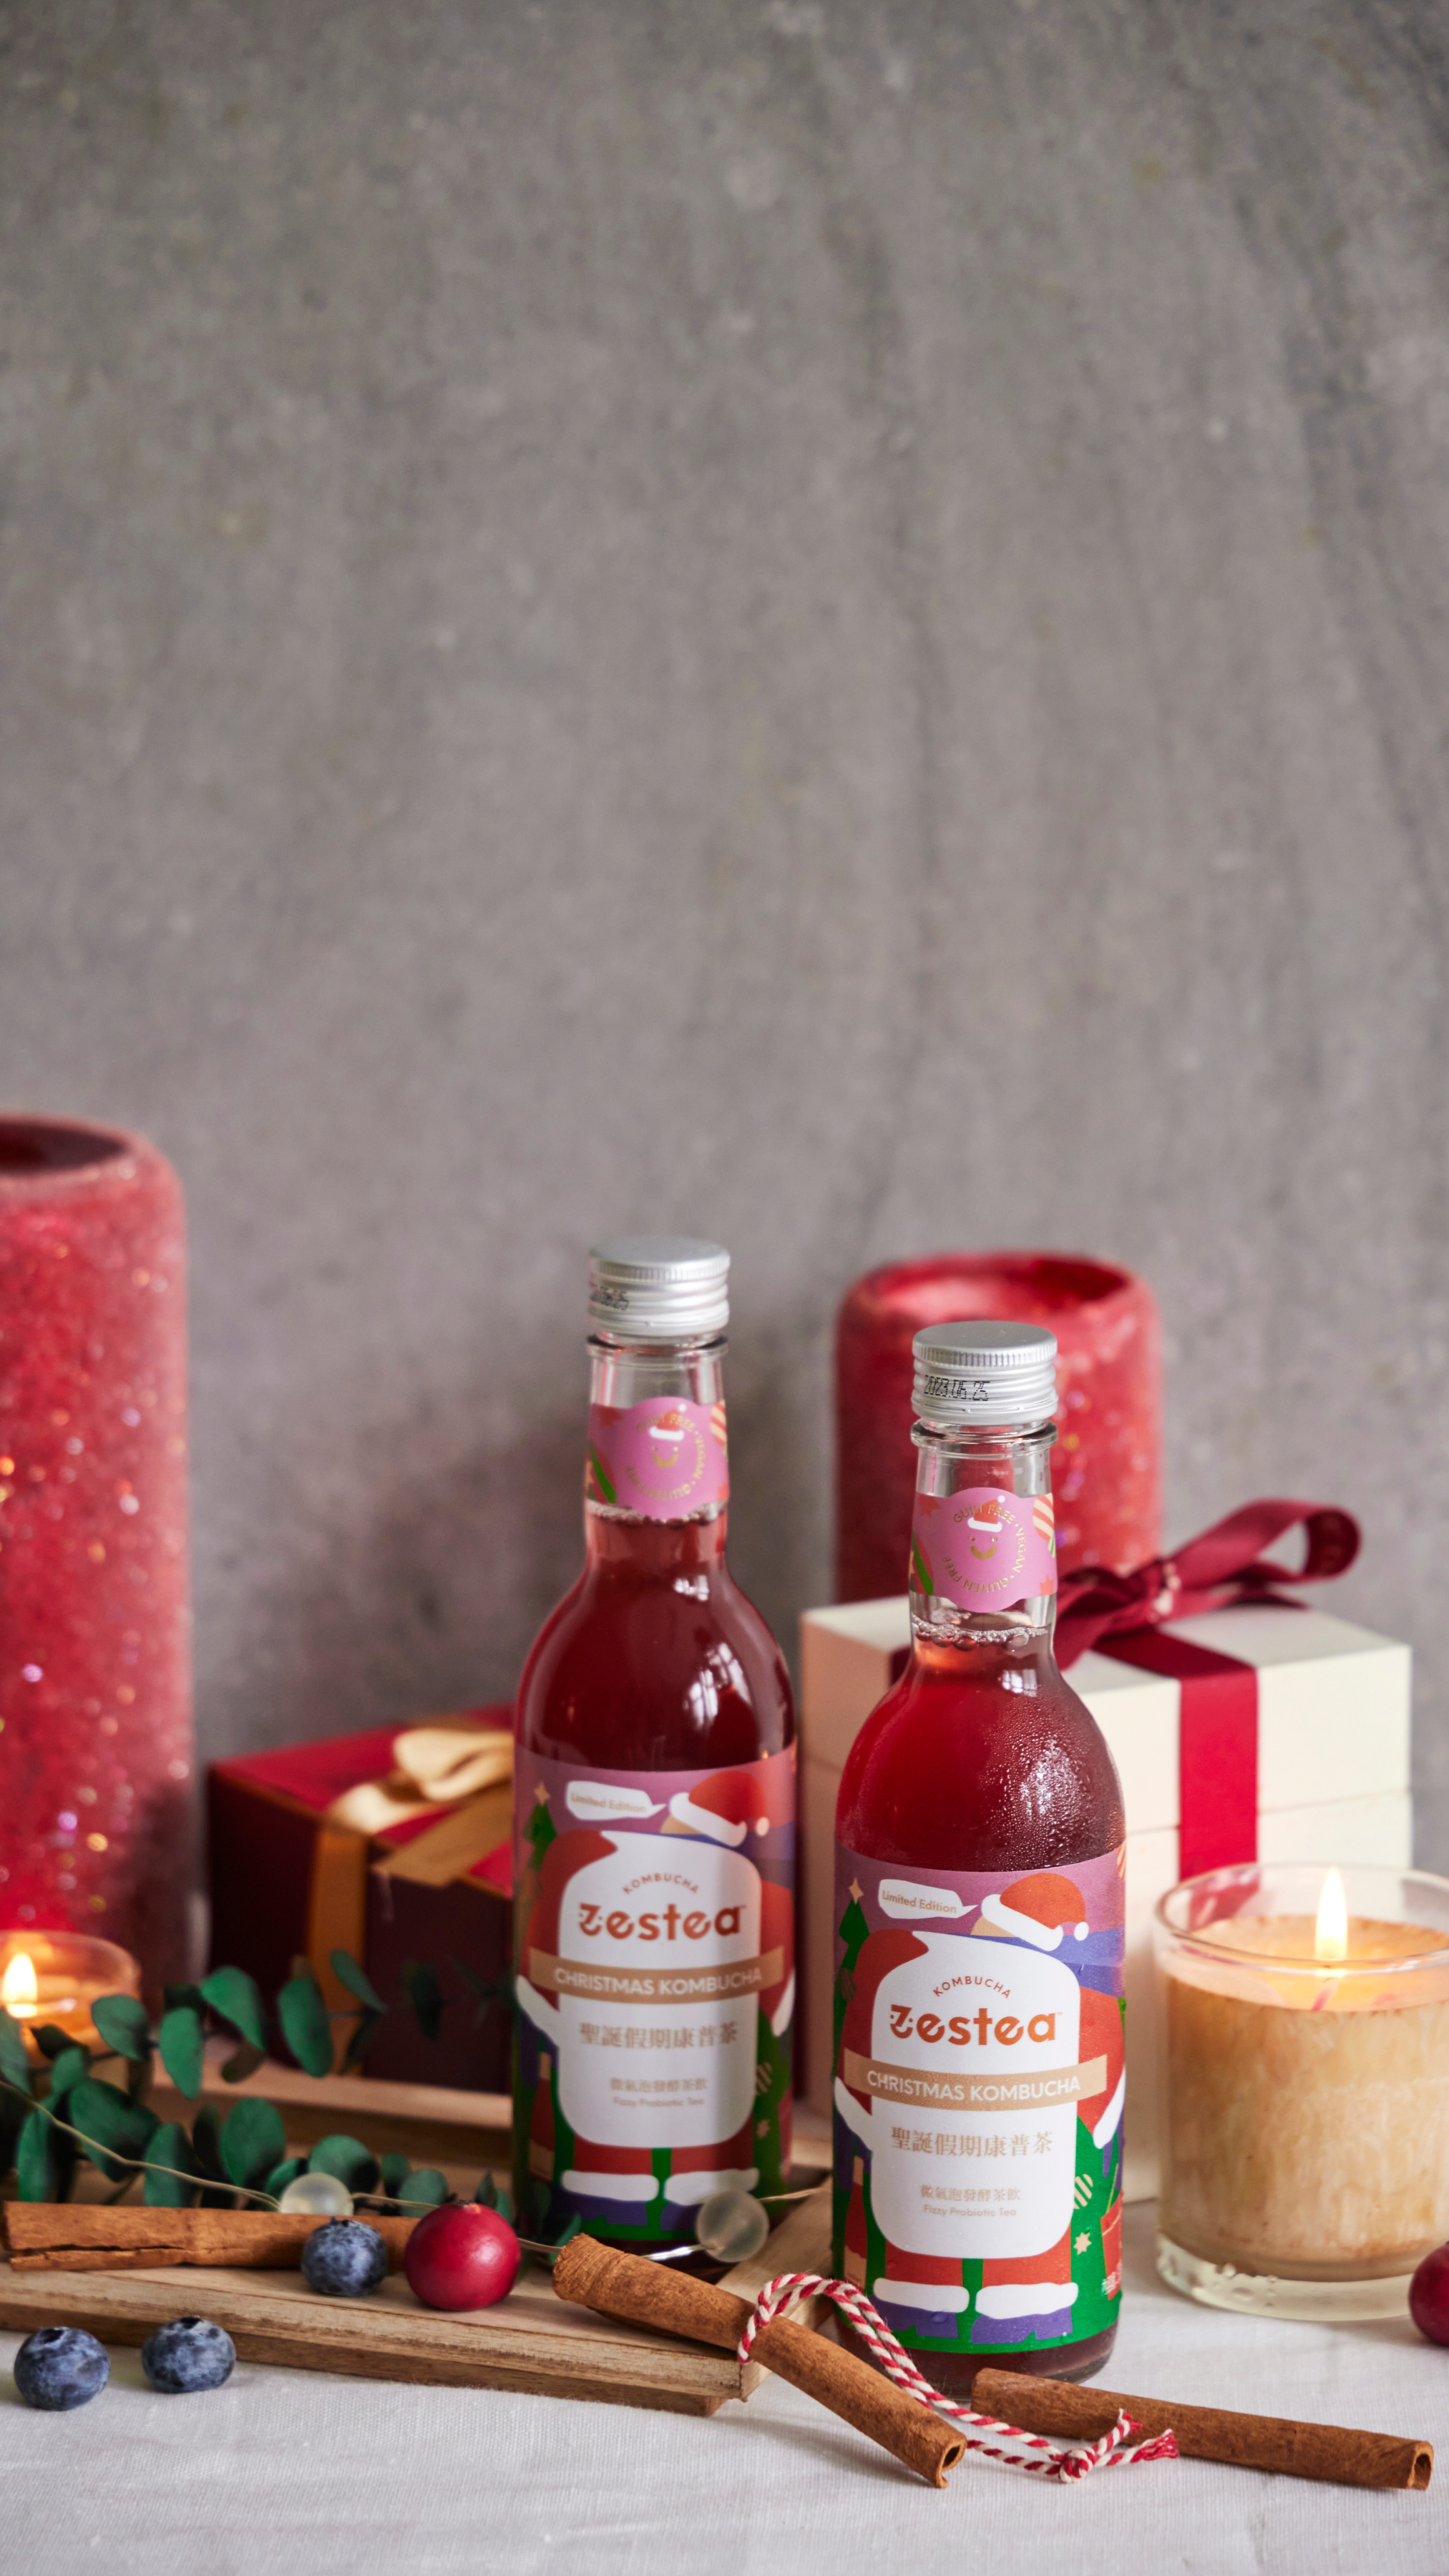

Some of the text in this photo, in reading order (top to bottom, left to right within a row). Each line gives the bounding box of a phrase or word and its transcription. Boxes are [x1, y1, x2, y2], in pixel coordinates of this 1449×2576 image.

[953, 1503, 1015, 1524] GUILT FREE
[1012, 1527, 1027, 1573] VEGAN
[944, 1556, 1010, 1594] GLUTEN FREE
[570, 1792, 646, 1813] Limited Edition
[623, 1873, 699, 1894] KOMBUCHA
[882, 1890, 957, 1913] Limited Edition
[555, 1967, 763, 1996] CHRISTMAS KOMBUCHA
[933, 1976, 1011, 1998] KOMBUCHA
[580, 2021, 738, 2049] 聖誕假期康普茶
[867, 2070, 1081, 2101] CHRISTMAS KOMBUCHA
[687, 2097, 704, 2105] Tea
[891, 2126, 1053, 2158] 聖誕假期康普茶
[924, 2204, 1017, 2217] Fizzy Probiotic Tea
